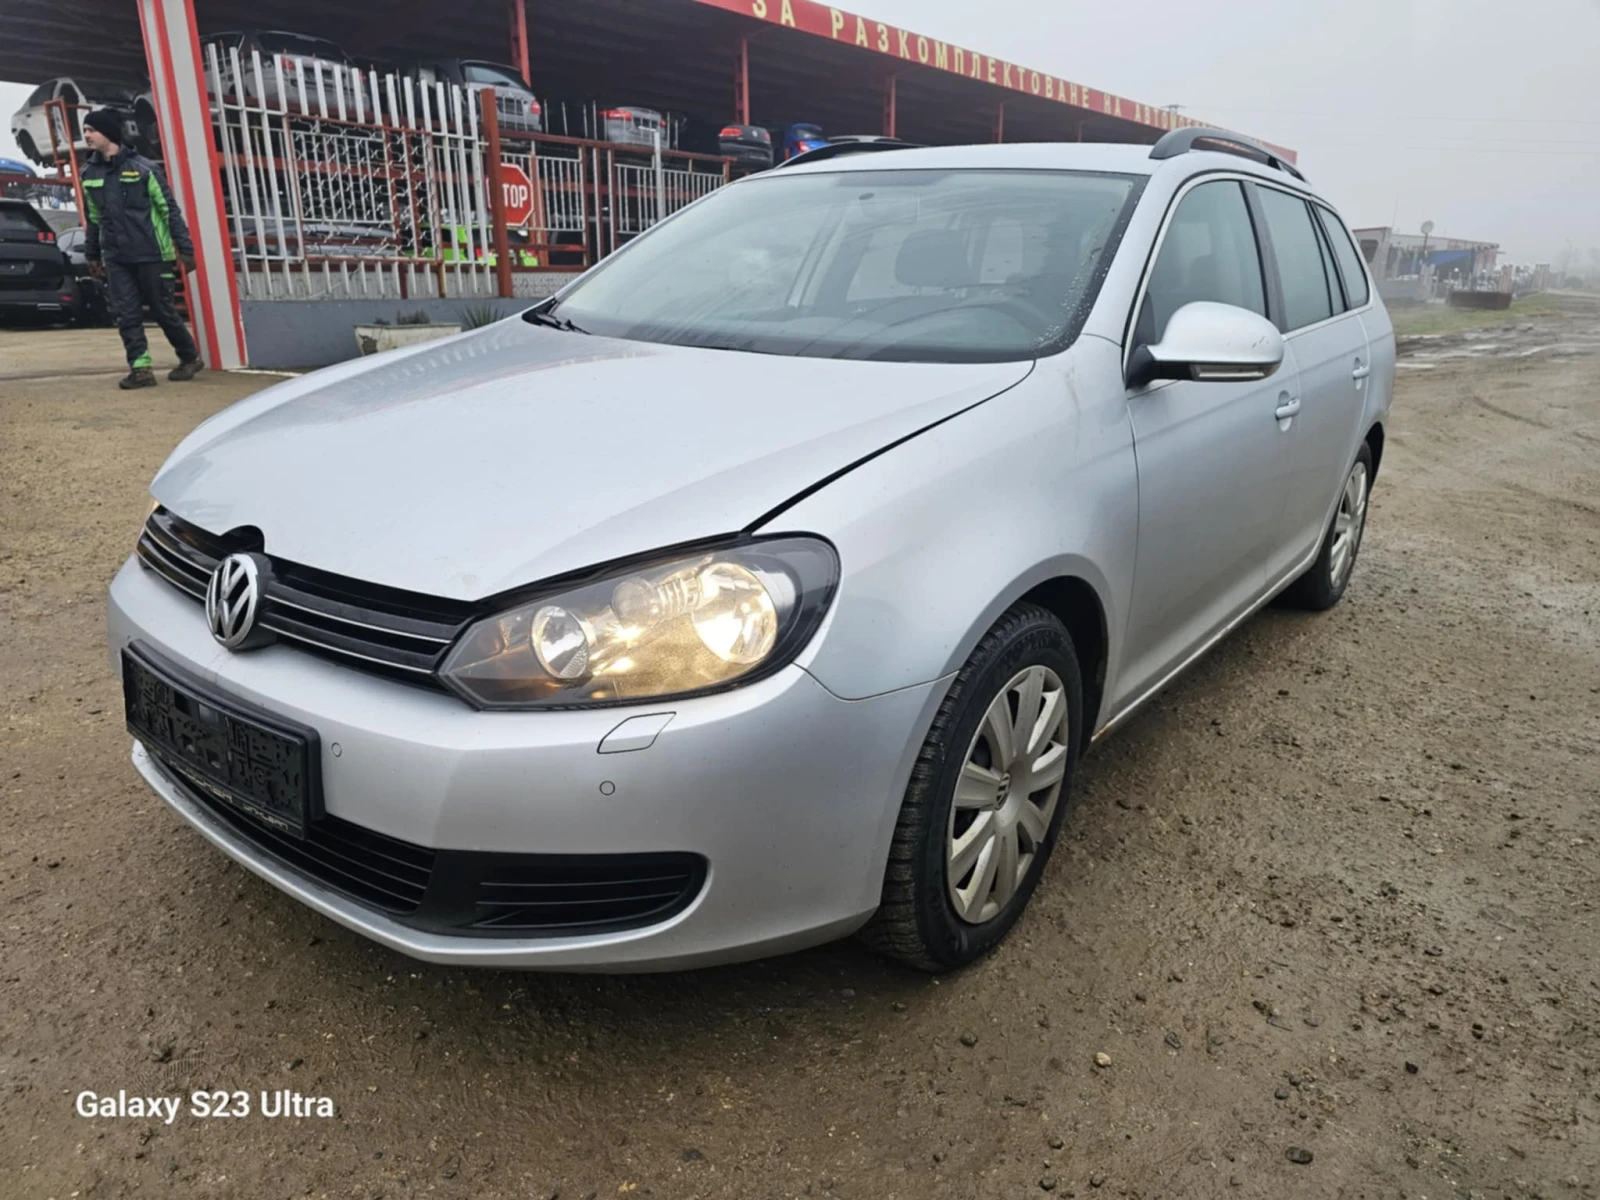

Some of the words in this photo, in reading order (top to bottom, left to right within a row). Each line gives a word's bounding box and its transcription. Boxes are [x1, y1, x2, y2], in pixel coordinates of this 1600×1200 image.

[752, 0, 796, 27] ЗА
[830, 7, 1090, 108] РАЗКОМПЛЕКТОВАНЕ
[1104, 92, 1122, 117] НА
[502, 183, 528, 209] TOP
